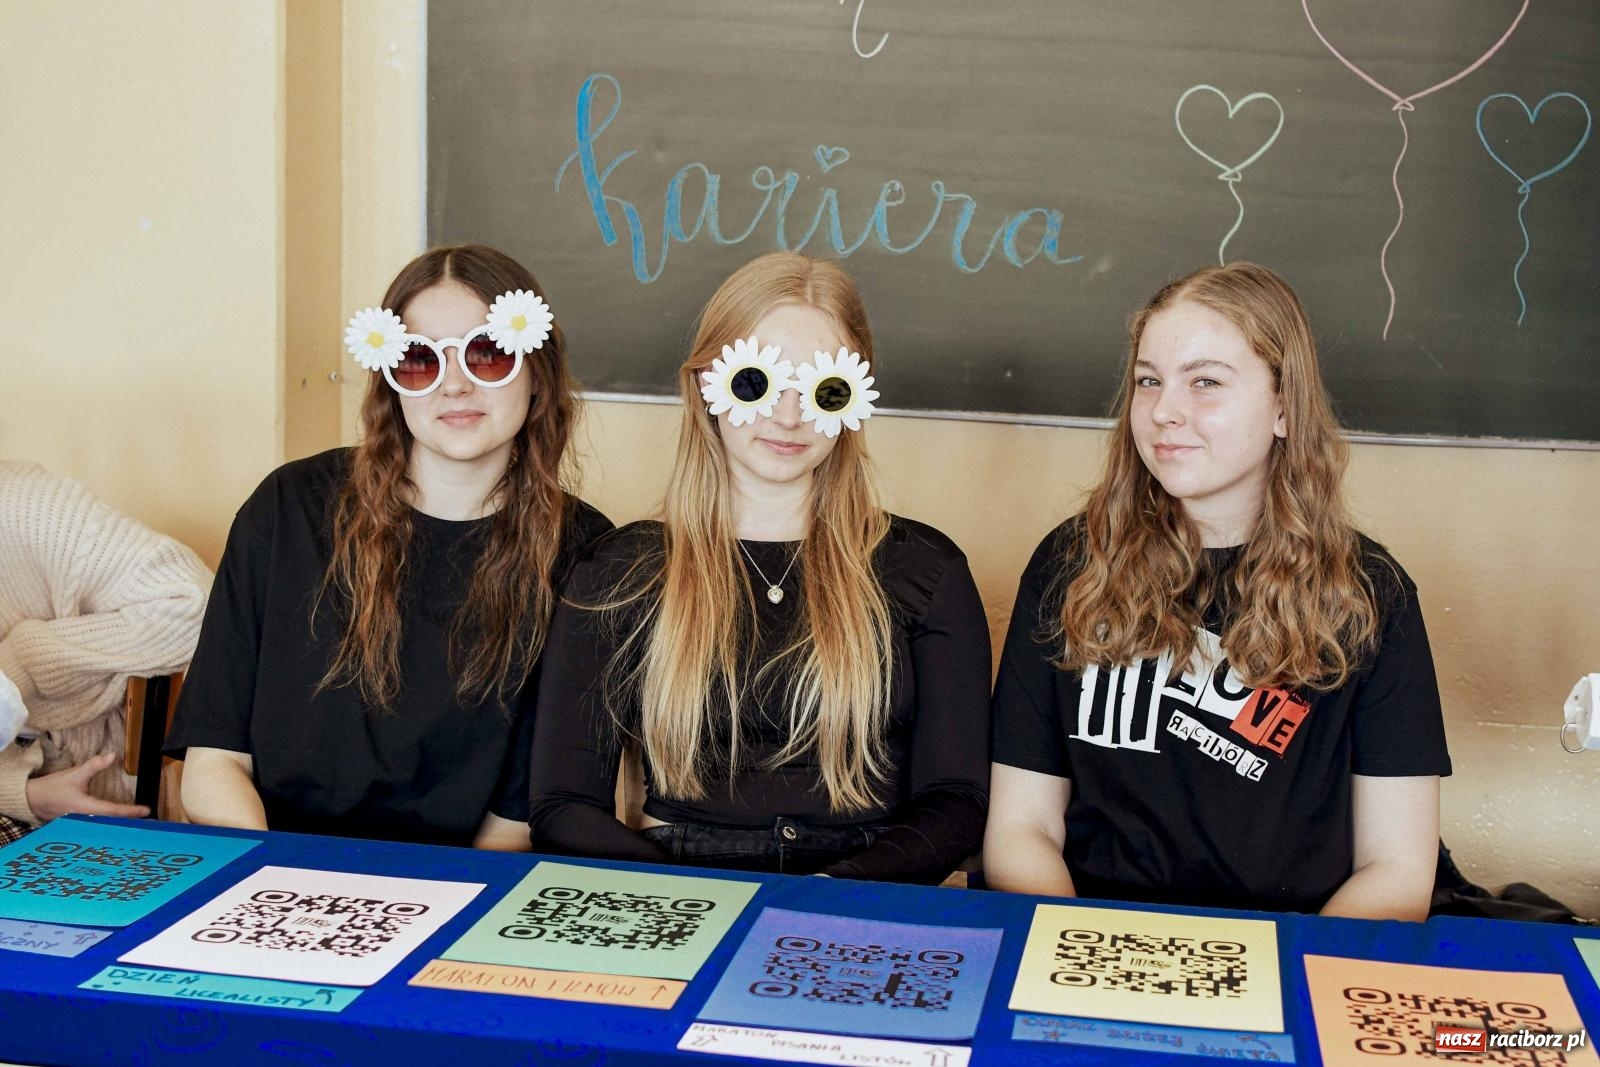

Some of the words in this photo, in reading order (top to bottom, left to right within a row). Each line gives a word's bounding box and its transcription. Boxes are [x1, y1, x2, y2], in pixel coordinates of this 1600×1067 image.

[107, 968, 201, 985] DZIEŃ
[420, 966, 536, 989] MARATON
[175, 987, 315, 1007] LICEALISTY
[693, 1024, 778, 1039] MARATON
